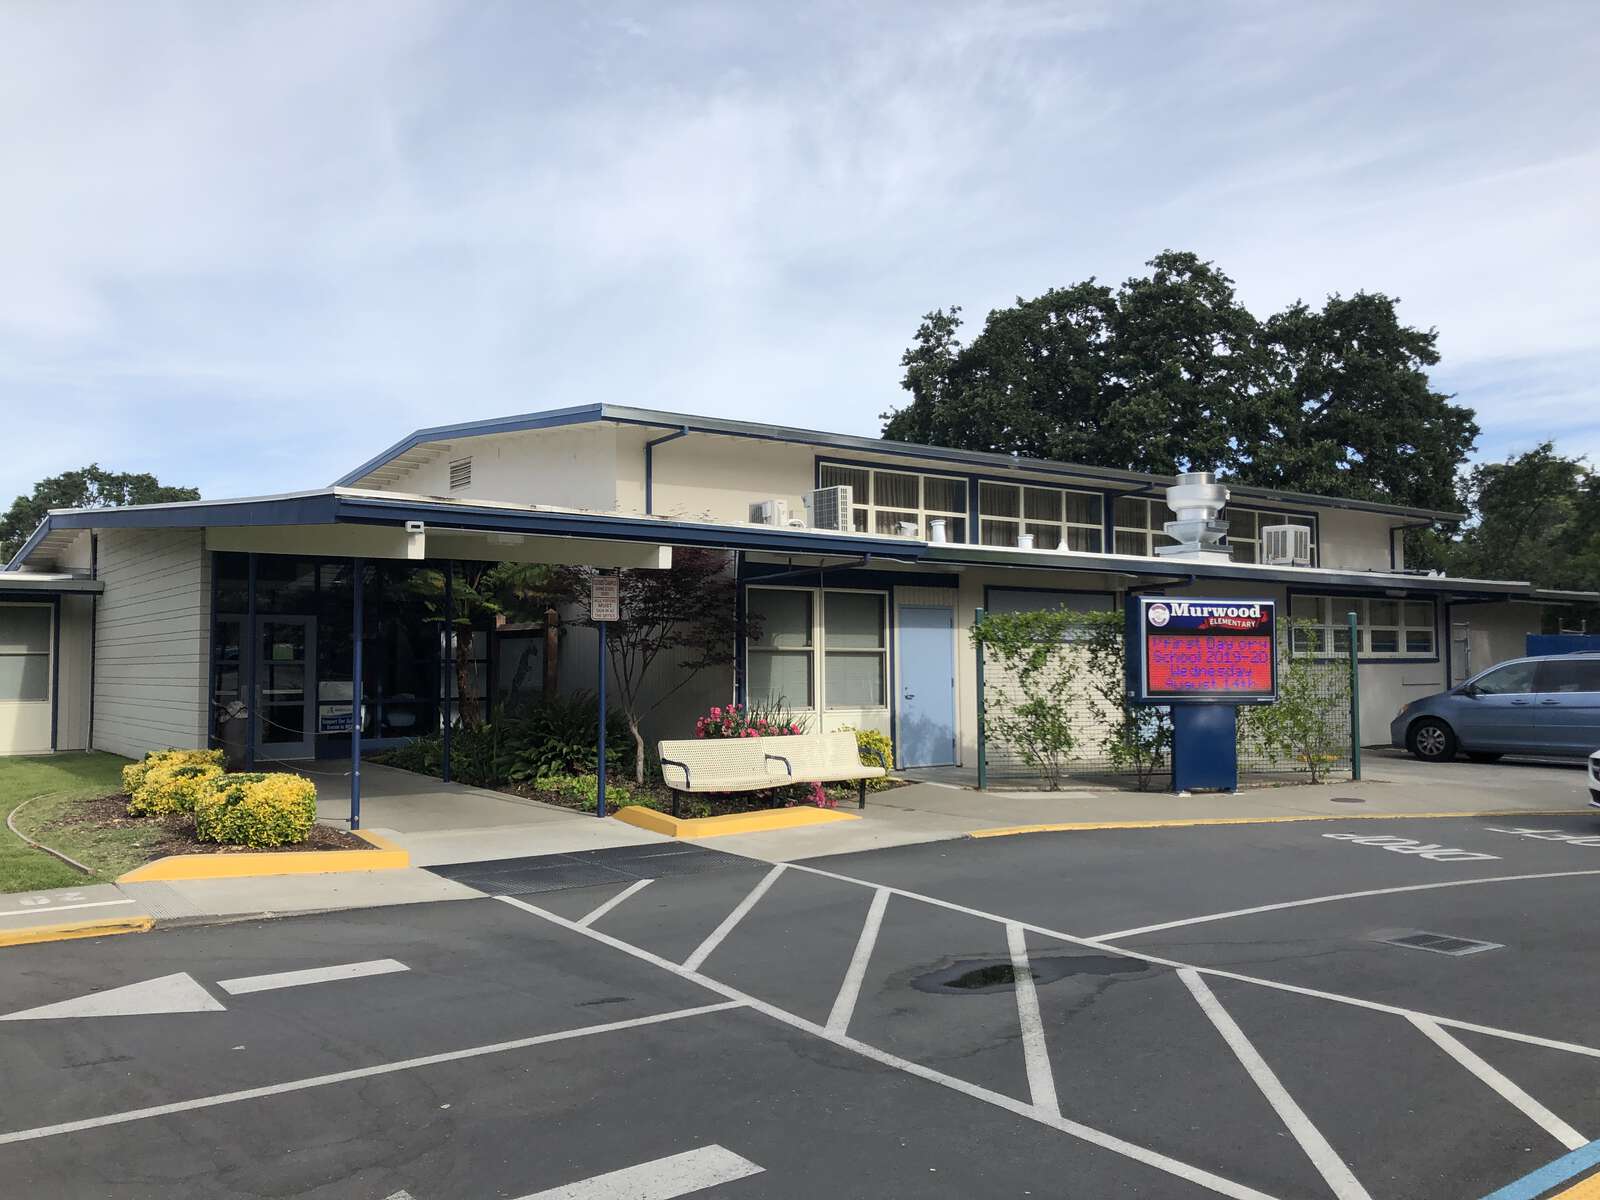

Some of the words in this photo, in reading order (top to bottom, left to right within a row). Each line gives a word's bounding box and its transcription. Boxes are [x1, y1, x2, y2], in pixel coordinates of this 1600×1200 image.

[1170, 603, 1261, 618] Murwood
[1209, 618, 1256, 628] ELEMENTARY
[1170, 665, 1253, 678] Wednesday
[1166, 679, 1216, 690] August
[1321, 832, 1503, 862] DROP
